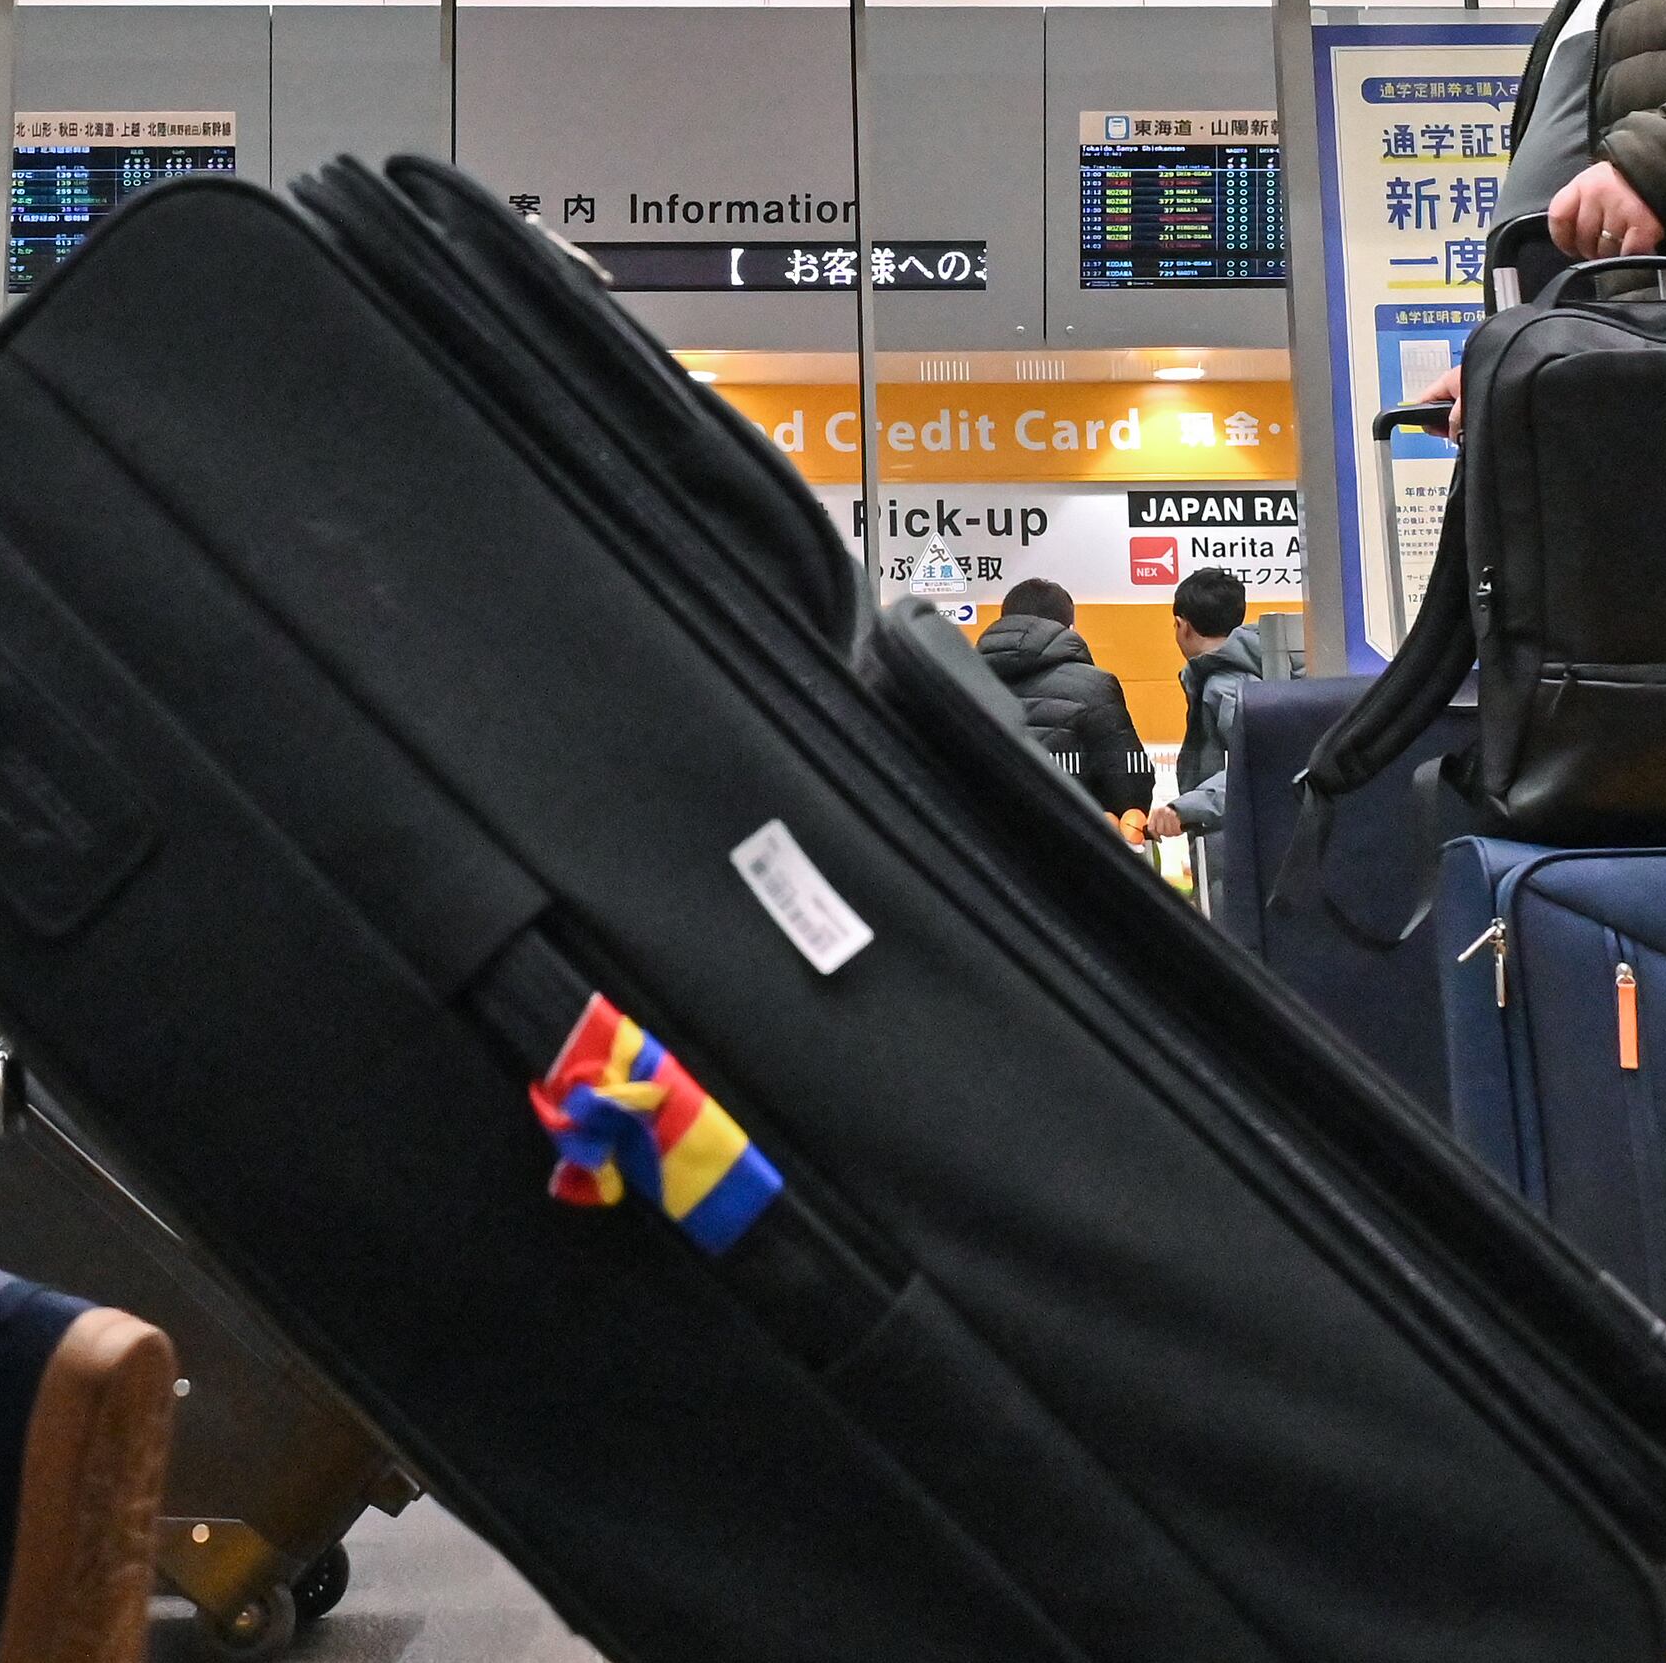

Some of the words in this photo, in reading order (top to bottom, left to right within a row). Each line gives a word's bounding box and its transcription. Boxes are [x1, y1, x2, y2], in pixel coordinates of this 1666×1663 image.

[1386, 176, 1499, 230] 新規
[1389, 237, 1486, 285] 一度
[825, 409, 996, 453] Cedit
[1015, 407, 1142, 451] Card
[853, 498, 1047, 546] Pick-up
[1141, 497, 1243, 523] JAPAN
[1254, 497, 1298, 523] RA
[1191, 536, 1274, 558] Narita
[1136, 566, 1158, 577] NEX
